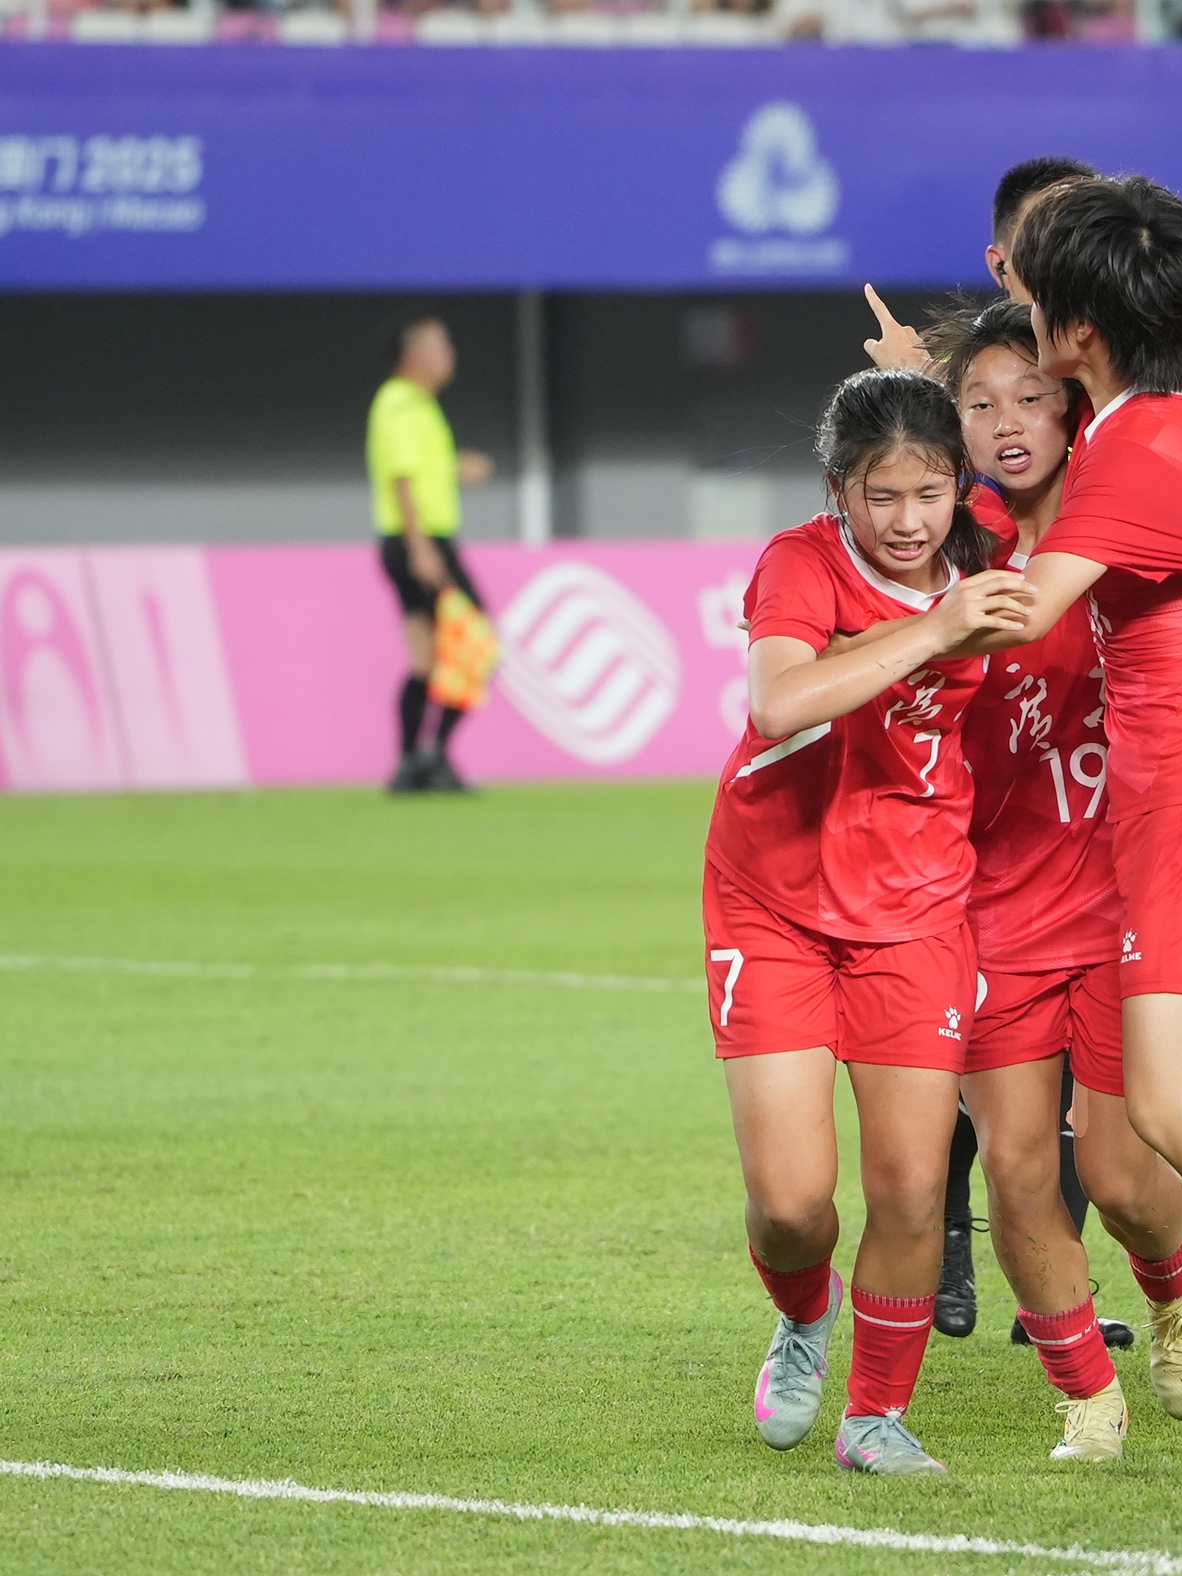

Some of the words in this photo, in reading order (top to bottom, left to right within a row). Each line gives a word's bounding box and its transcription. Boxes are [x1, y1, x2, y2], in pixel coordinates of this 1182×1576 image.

[913, 729, 942, 798] 7
[1039, 742, 1108, 823] 19
[710, 948, 745, 1026] 7
